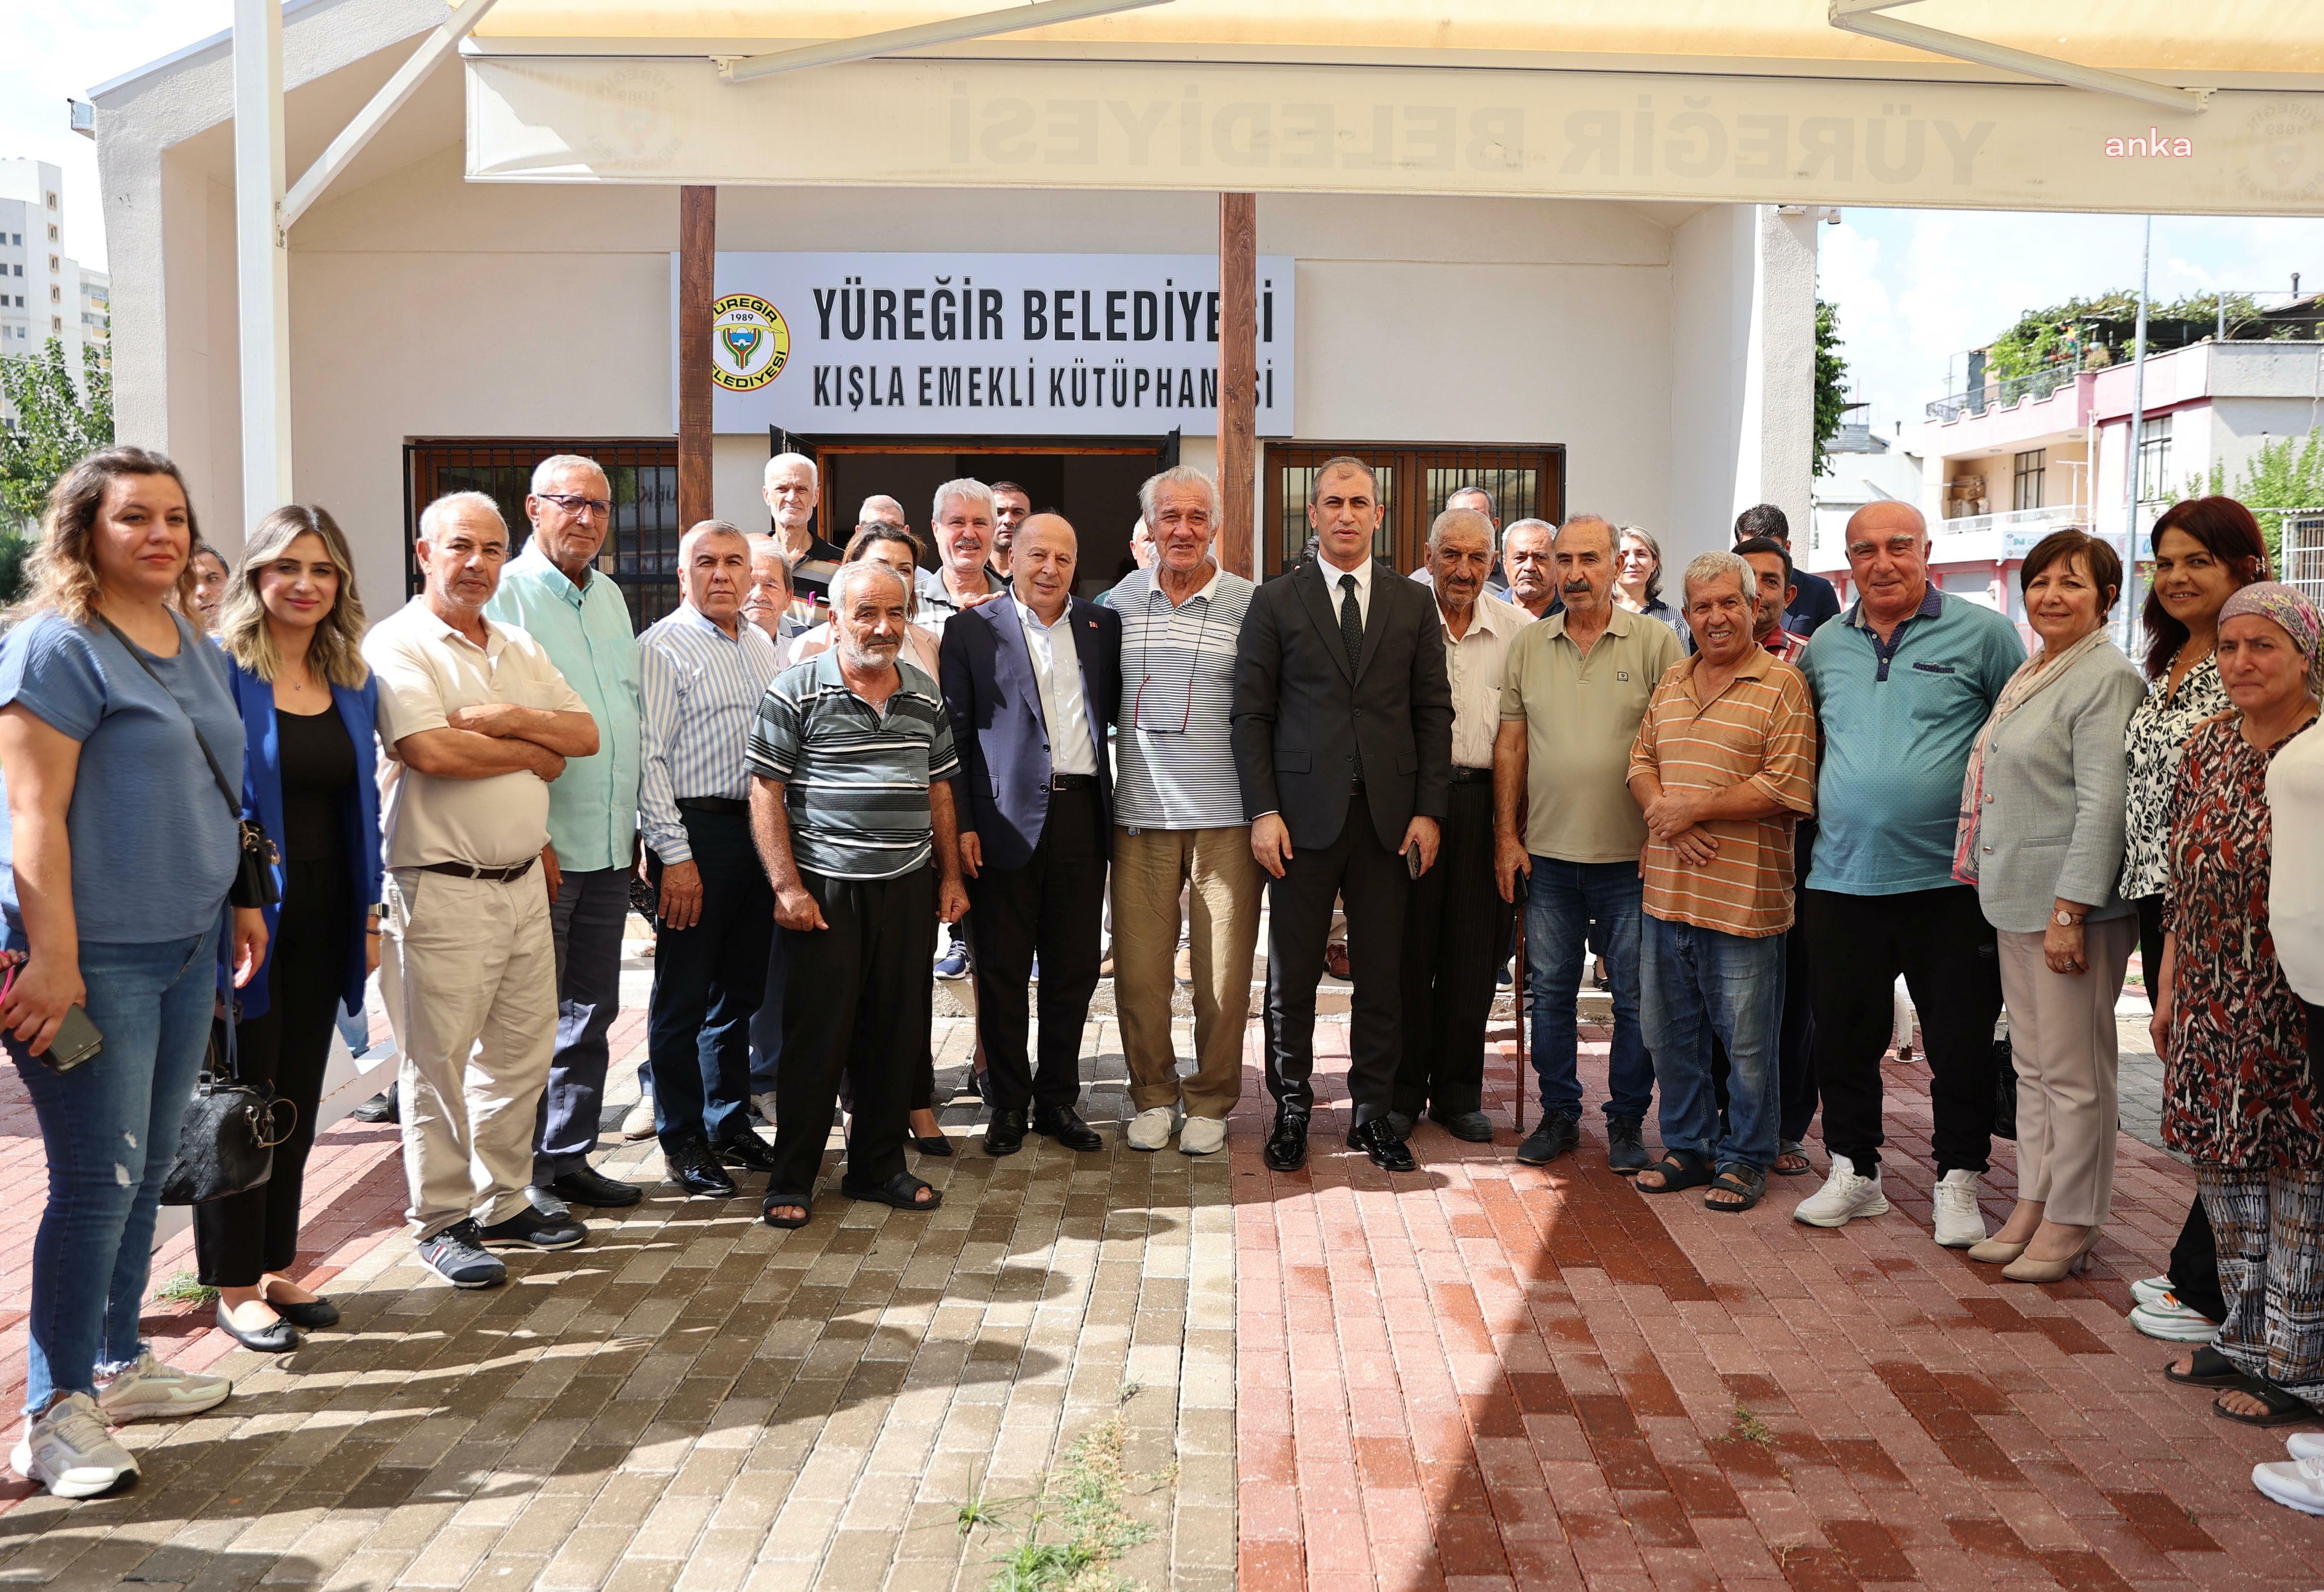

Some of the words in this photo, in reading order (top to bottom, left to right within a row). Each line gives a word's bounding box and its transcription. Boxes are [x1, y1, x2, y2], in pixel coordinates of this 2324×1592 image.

[714, 297, 778, 323] ÜREĞİR
[812, 277, 1004, 341] YÜREĞİR
[1023, 279, 1272, 342] BELEDİYEİ
[713, 351, 786, 388] LEDİYESİ
[814, 365, 904, 412] KIŞLA
[919, 357, 1035, 407] EMEKLİ
[1050, 358, 1272, 408] KÜTÜPHANİ
